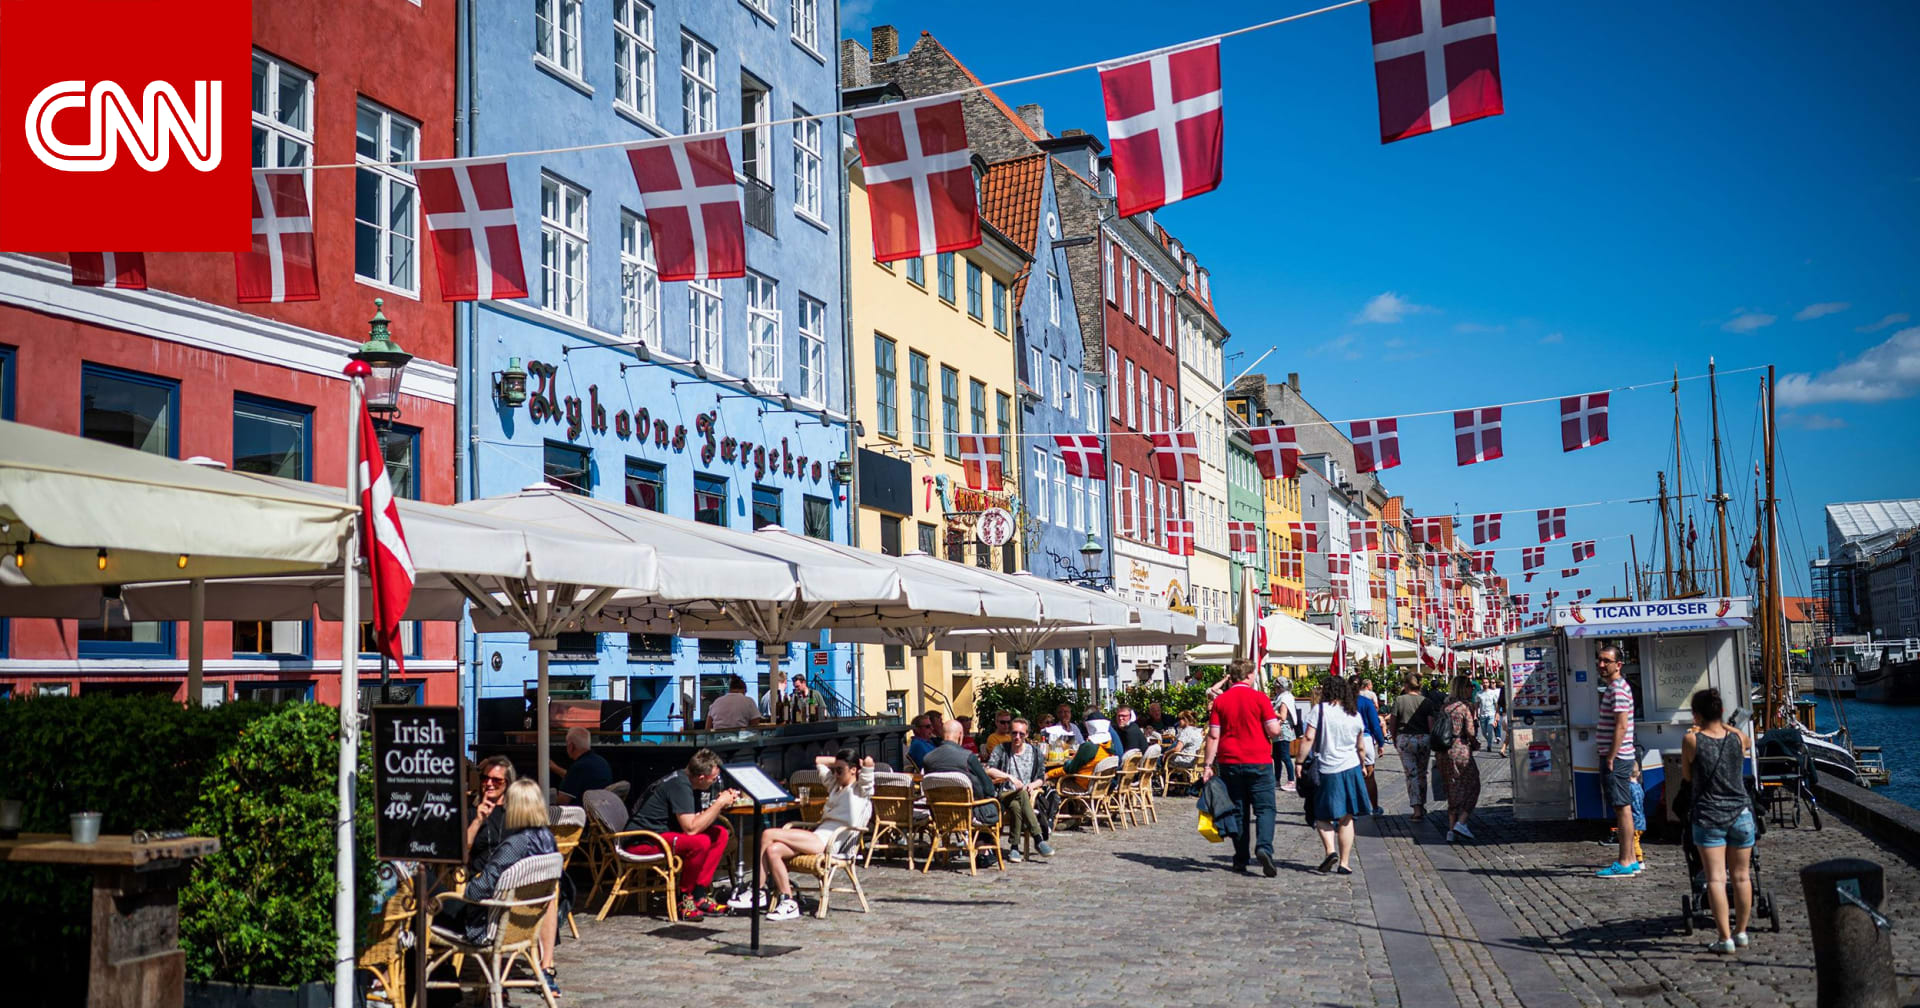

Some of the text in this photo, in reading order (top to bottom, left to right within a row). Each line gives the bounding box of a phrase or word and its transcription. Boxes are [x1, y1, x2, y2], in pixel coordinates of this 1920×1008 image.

[527, 360, 822, 483] Nyhavns Færgekro
[1592, 603, 1708, 619] TICAN PØLSER
[392, 718, 445, 744] Irish
[385, 749, 455, 775] Coffee
